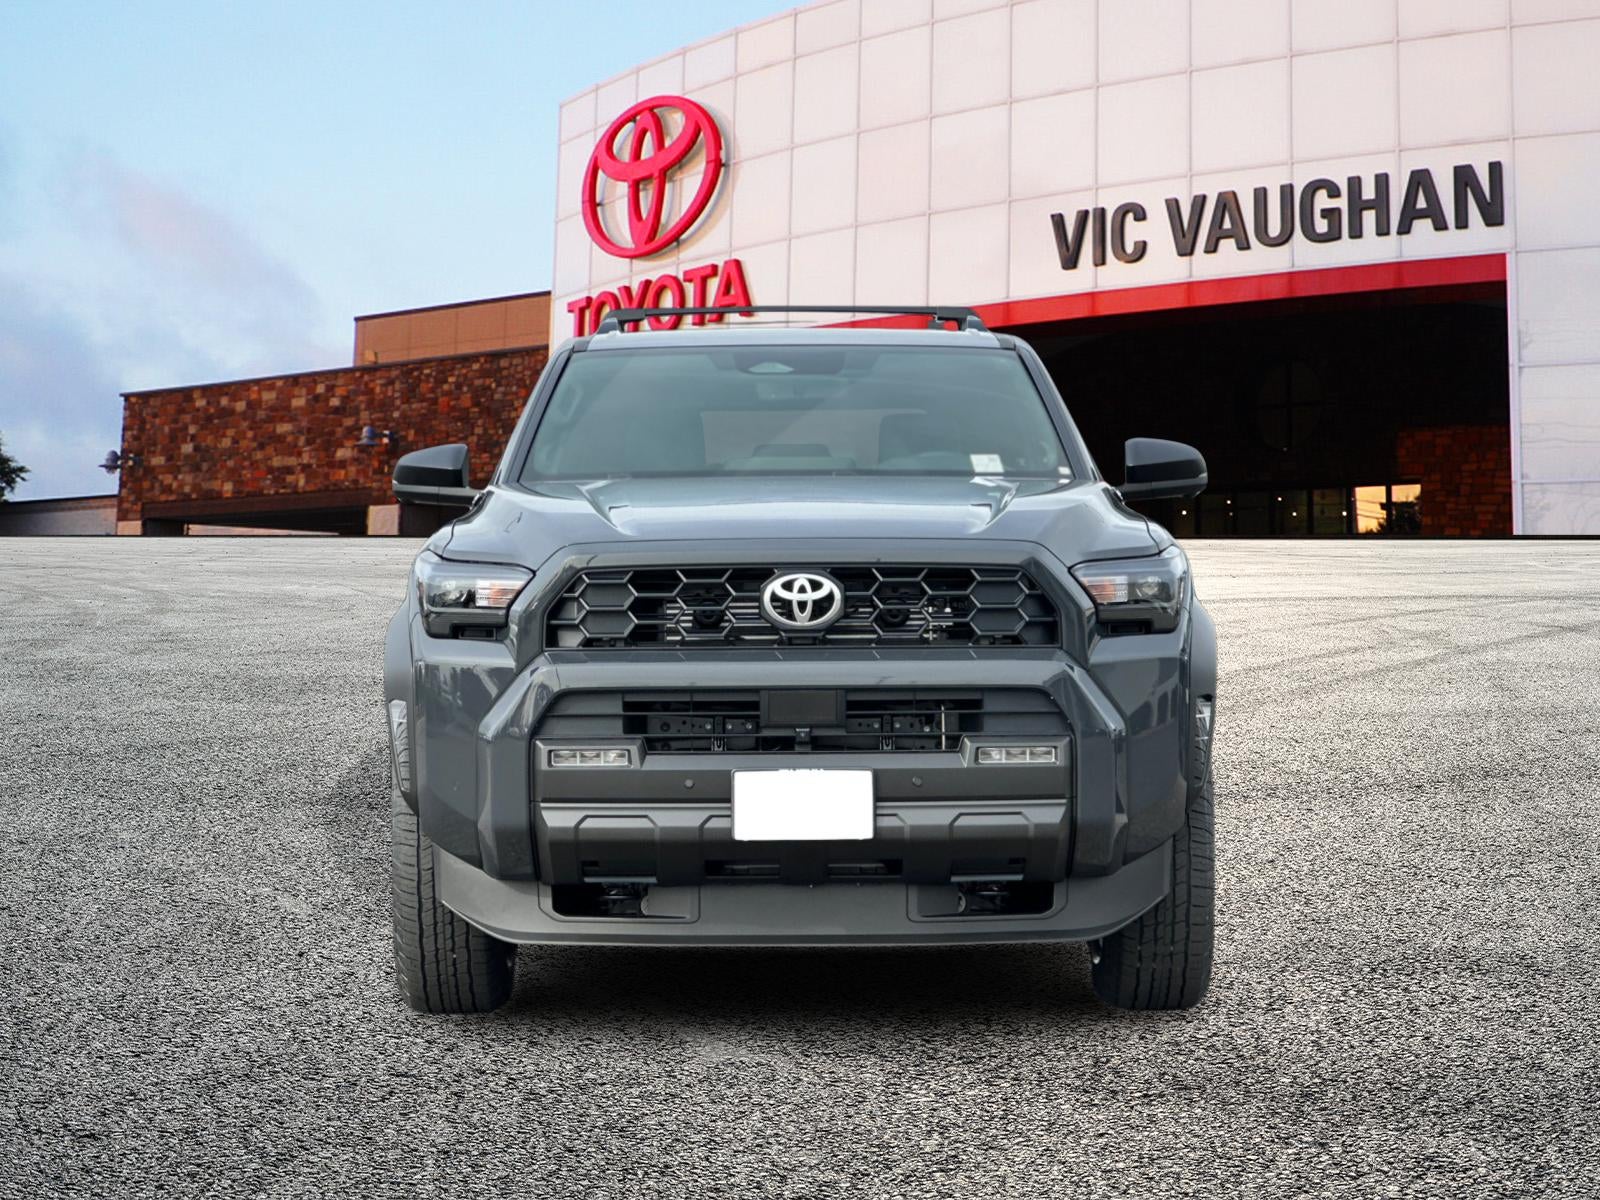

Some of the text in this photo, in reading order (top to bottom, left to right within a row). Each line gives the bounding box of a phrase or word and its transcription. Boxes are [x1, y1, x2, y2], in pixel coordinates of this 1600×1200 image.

[1050, 160, 1505, 271] VIC VAUGHAN
[567, 258, 755, 337] TOYOTA
